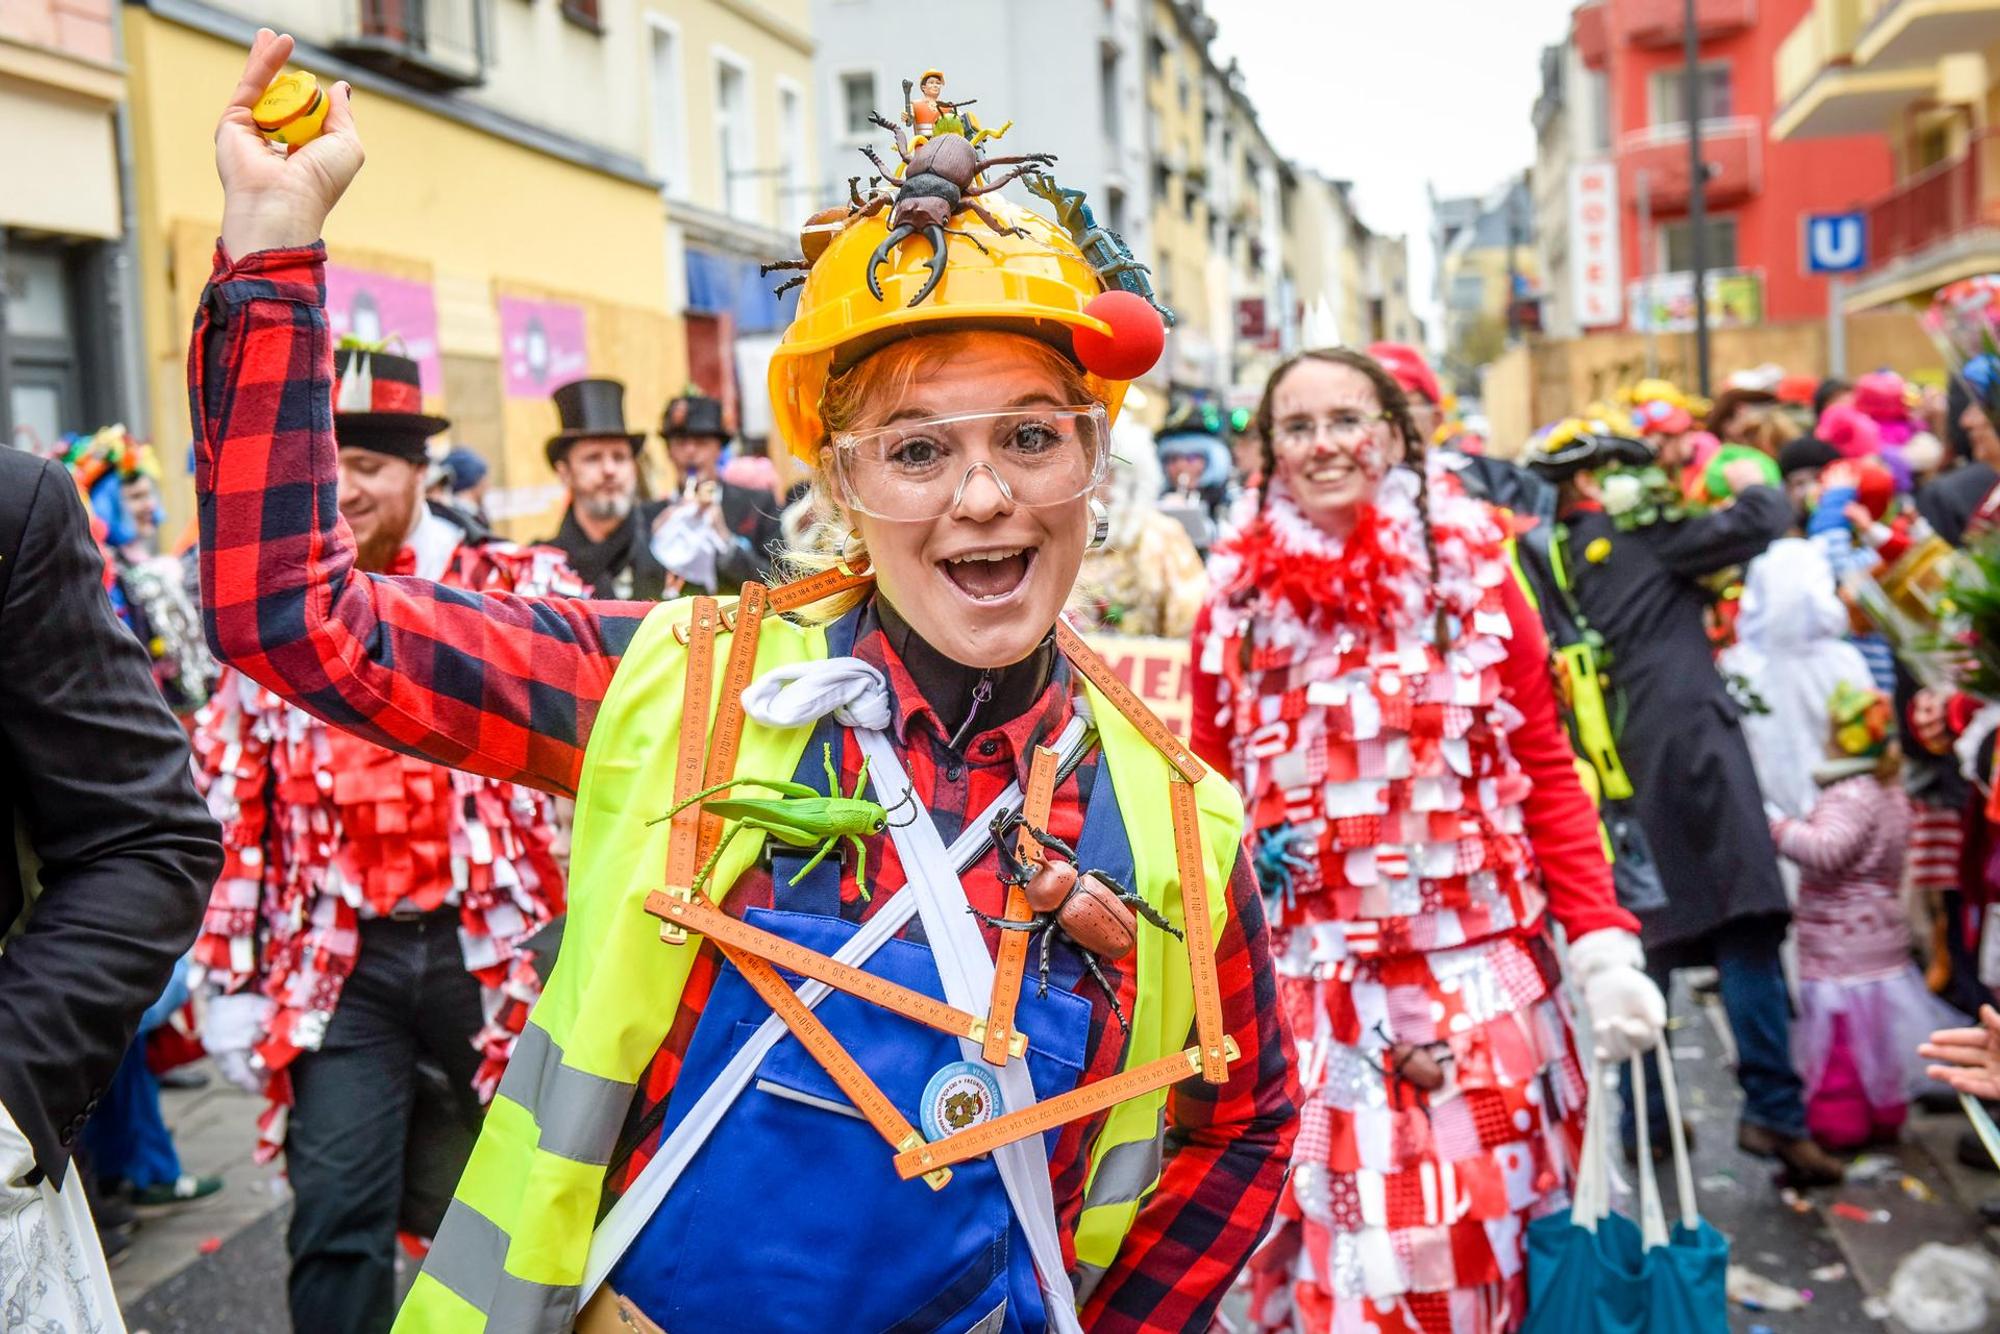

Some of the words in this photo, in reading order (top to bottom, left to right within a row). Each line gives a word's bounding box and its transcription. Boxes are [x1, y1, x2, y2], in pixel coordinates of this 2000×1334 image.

[1815, 221, 1859, 266] U
[770, 596, 783, 606] 182
[797, 585, 810, 596] 184
[1066, 638, 1081, 654] 90
[736, 658, 746, 671] 176
[734, 673, 743, 685] 175
[731, 687, 741, 699] 174
[729, 702, 738, 713] 173
[726, 716, 735, 728] 172
[718, 739, 732, 757] 170
[685, 756, 698, 770] 50
[1189, 896, 1202, 912] 110
[830, 965, 847, 980] 30
[797, 1015, 816, 1035] 150
[1060, 1098, 1079, 1113] 130
